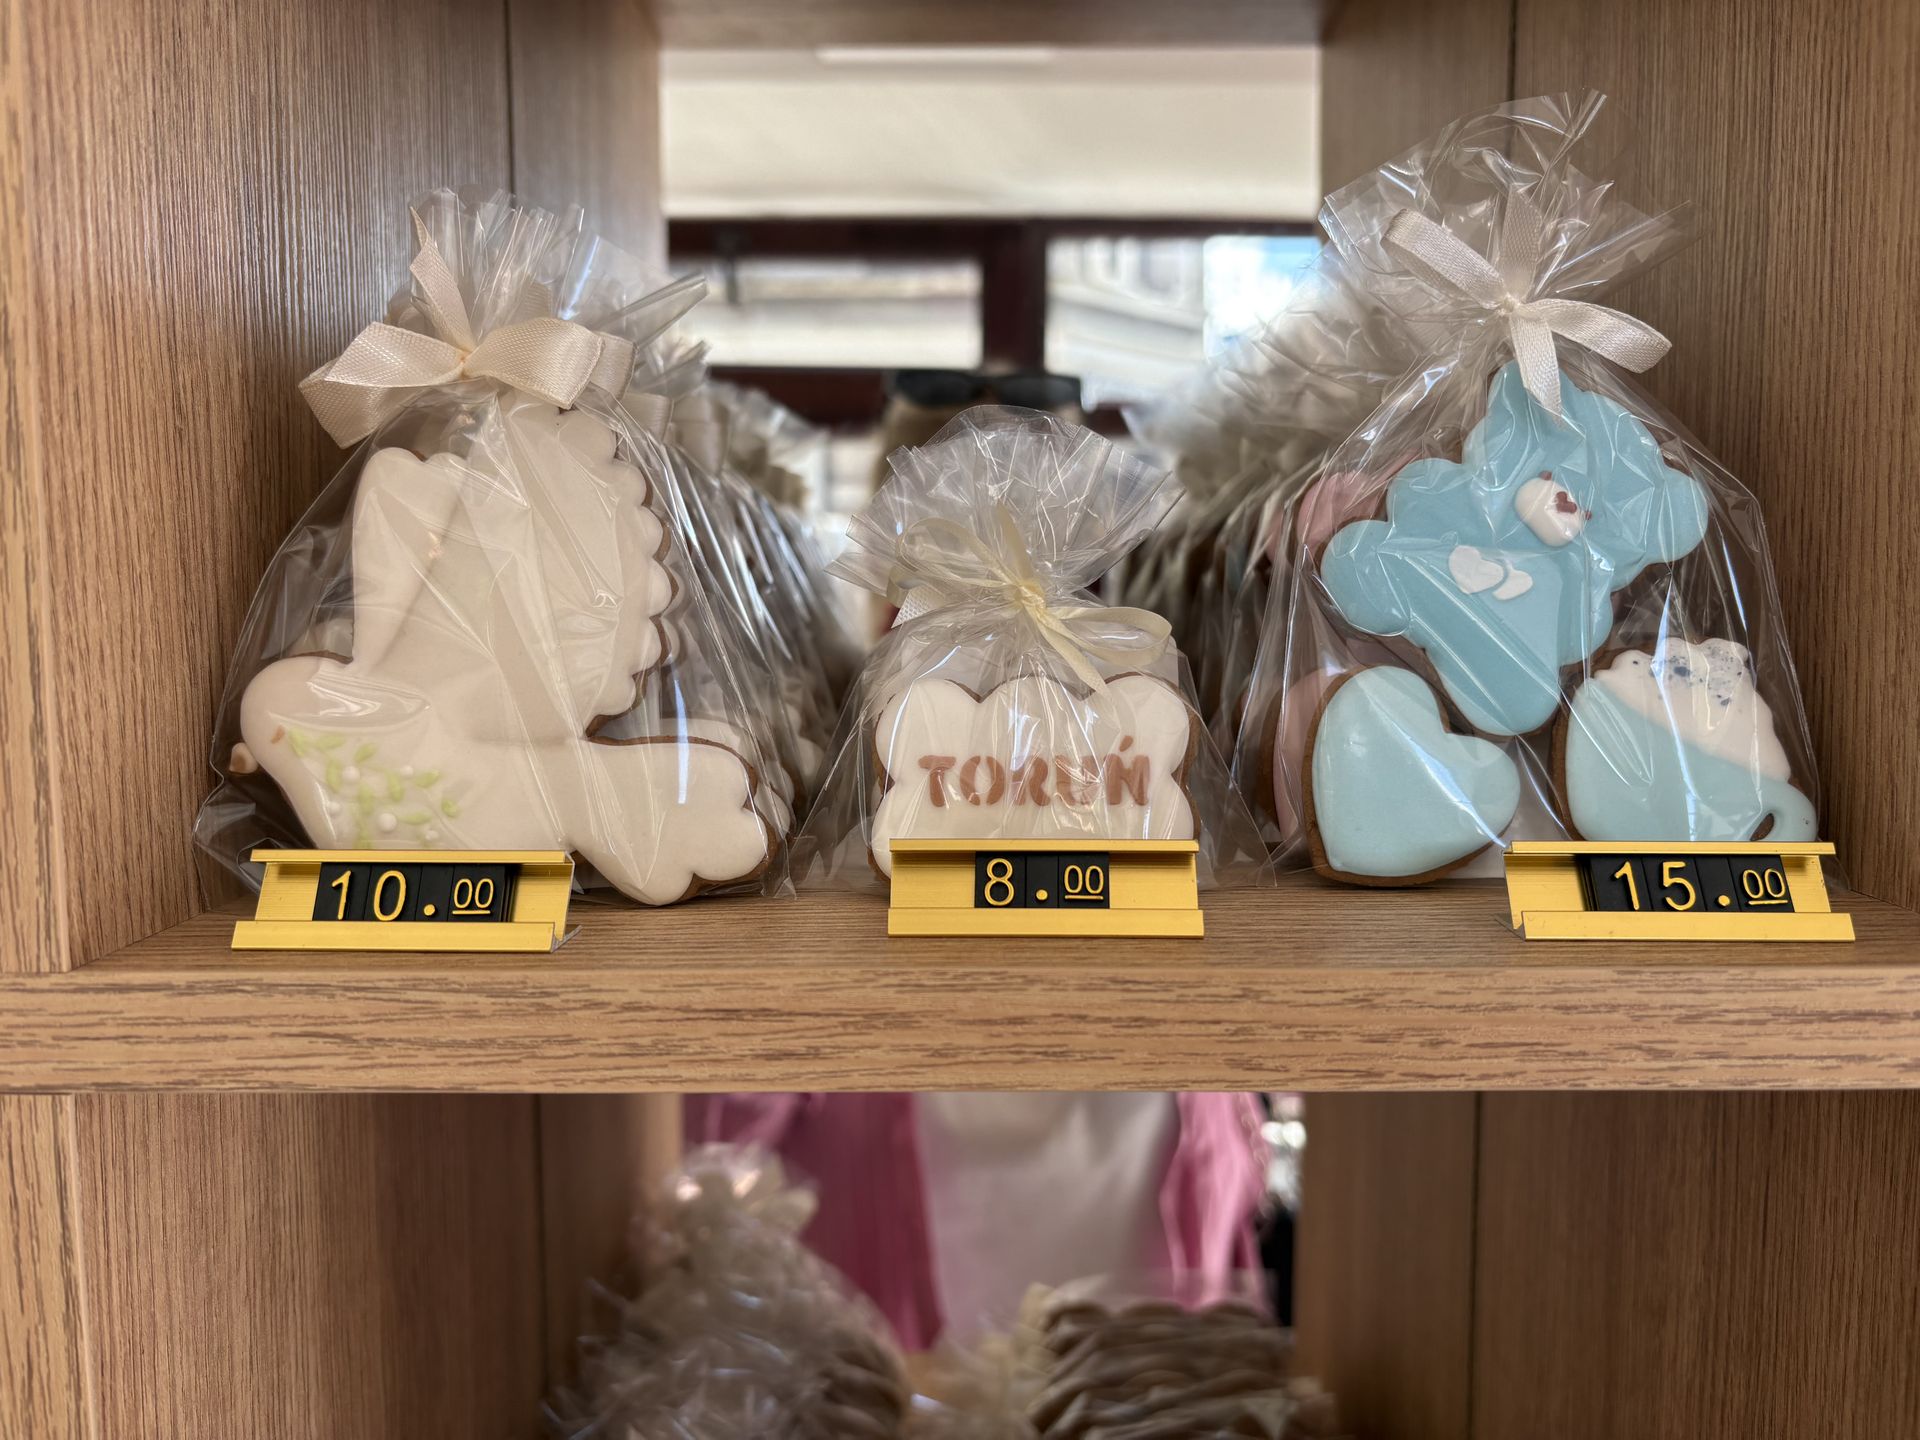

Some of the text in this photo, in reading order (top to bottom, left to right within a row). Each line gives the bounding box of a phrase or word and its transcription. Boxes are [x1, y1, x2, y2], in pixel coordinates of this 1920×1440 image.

[917, 735, 1150, 807] TORUŃ
[331, 870, 494, 921] 10.00
[984, 857, 1104, 906] 8.00
[1613, 861, 1788, 911] 15.00
